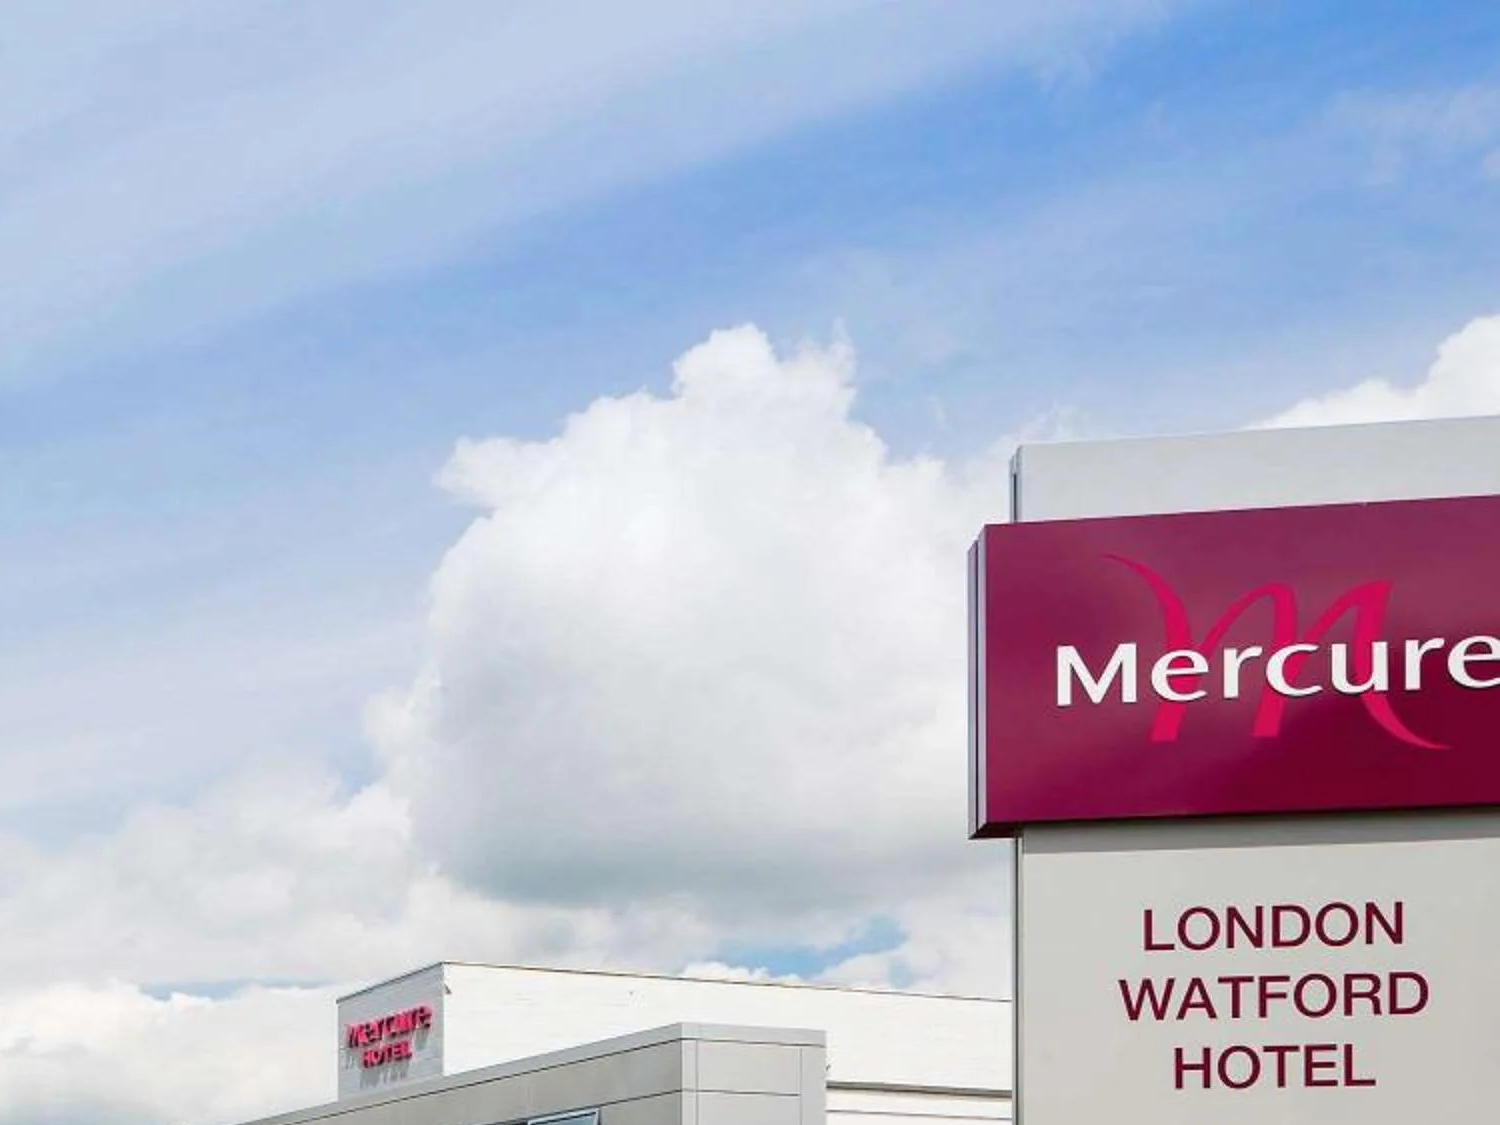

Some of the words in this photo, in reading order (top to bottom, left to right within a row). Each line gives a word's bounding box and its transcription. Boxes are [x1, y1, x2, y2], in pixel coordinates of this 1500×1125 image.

[1056, 634, 1500, 706] Mercure
[1143, 901, 1404, 951] LONDON
[1117, 971, 1430, 1021] WATFORD
[362, 1040, 412, 1067] HOTEL
[1173, 1043, 1378, 1090] HOTEL
